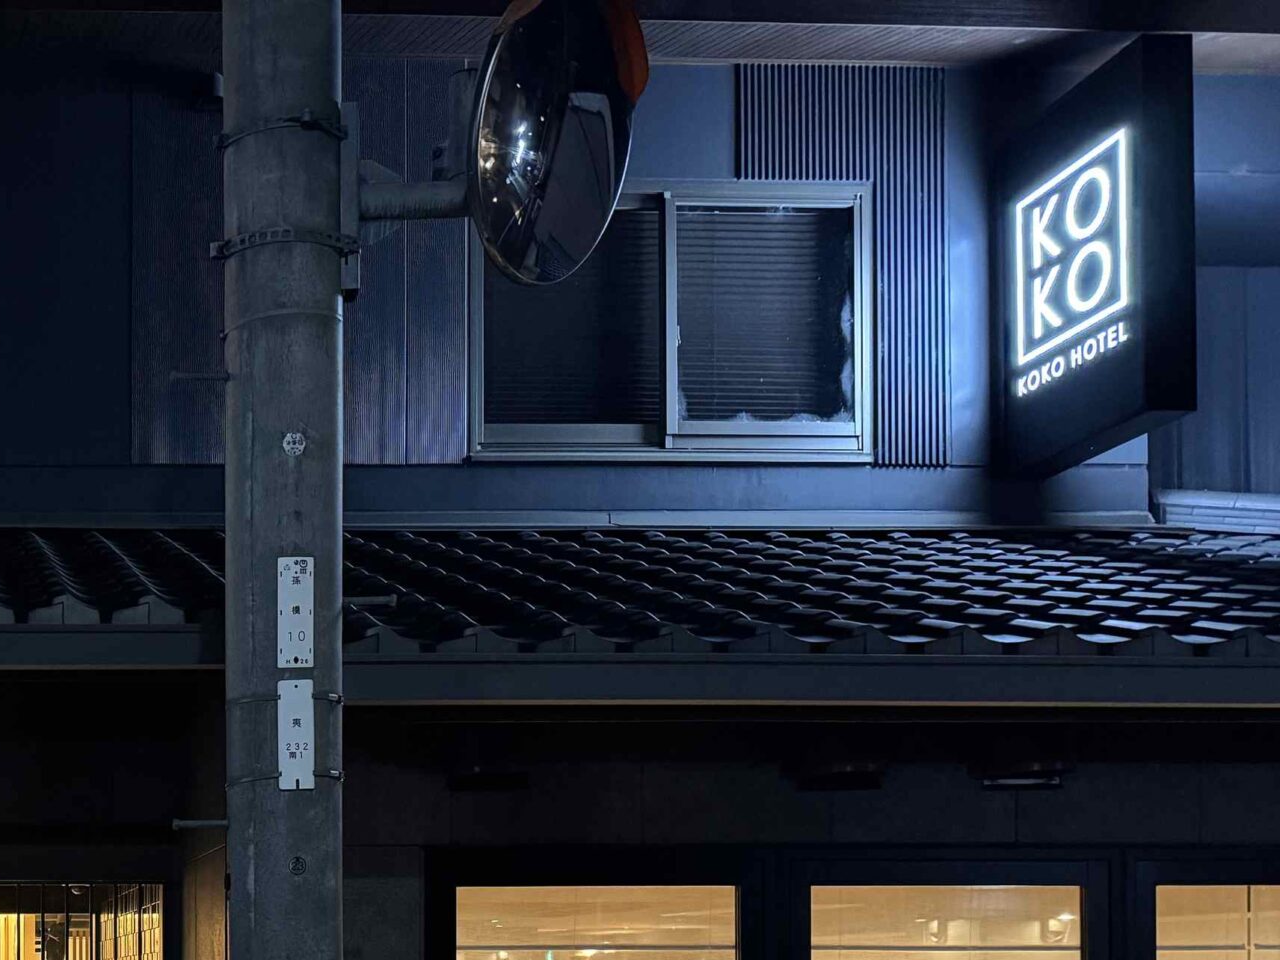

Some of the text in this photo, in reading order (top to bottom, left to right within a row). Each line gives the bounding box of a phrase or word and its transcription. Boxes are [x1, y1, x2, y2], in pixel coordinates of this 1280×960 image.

[1032, 166, 1111, 269] KO
[1033, 240, 1112, 339] KO
[1017, 321, 1128, 397] KOKO HOTEL
[287, 630, 306, 642] 10
[285, 742, 309, 751] 232
